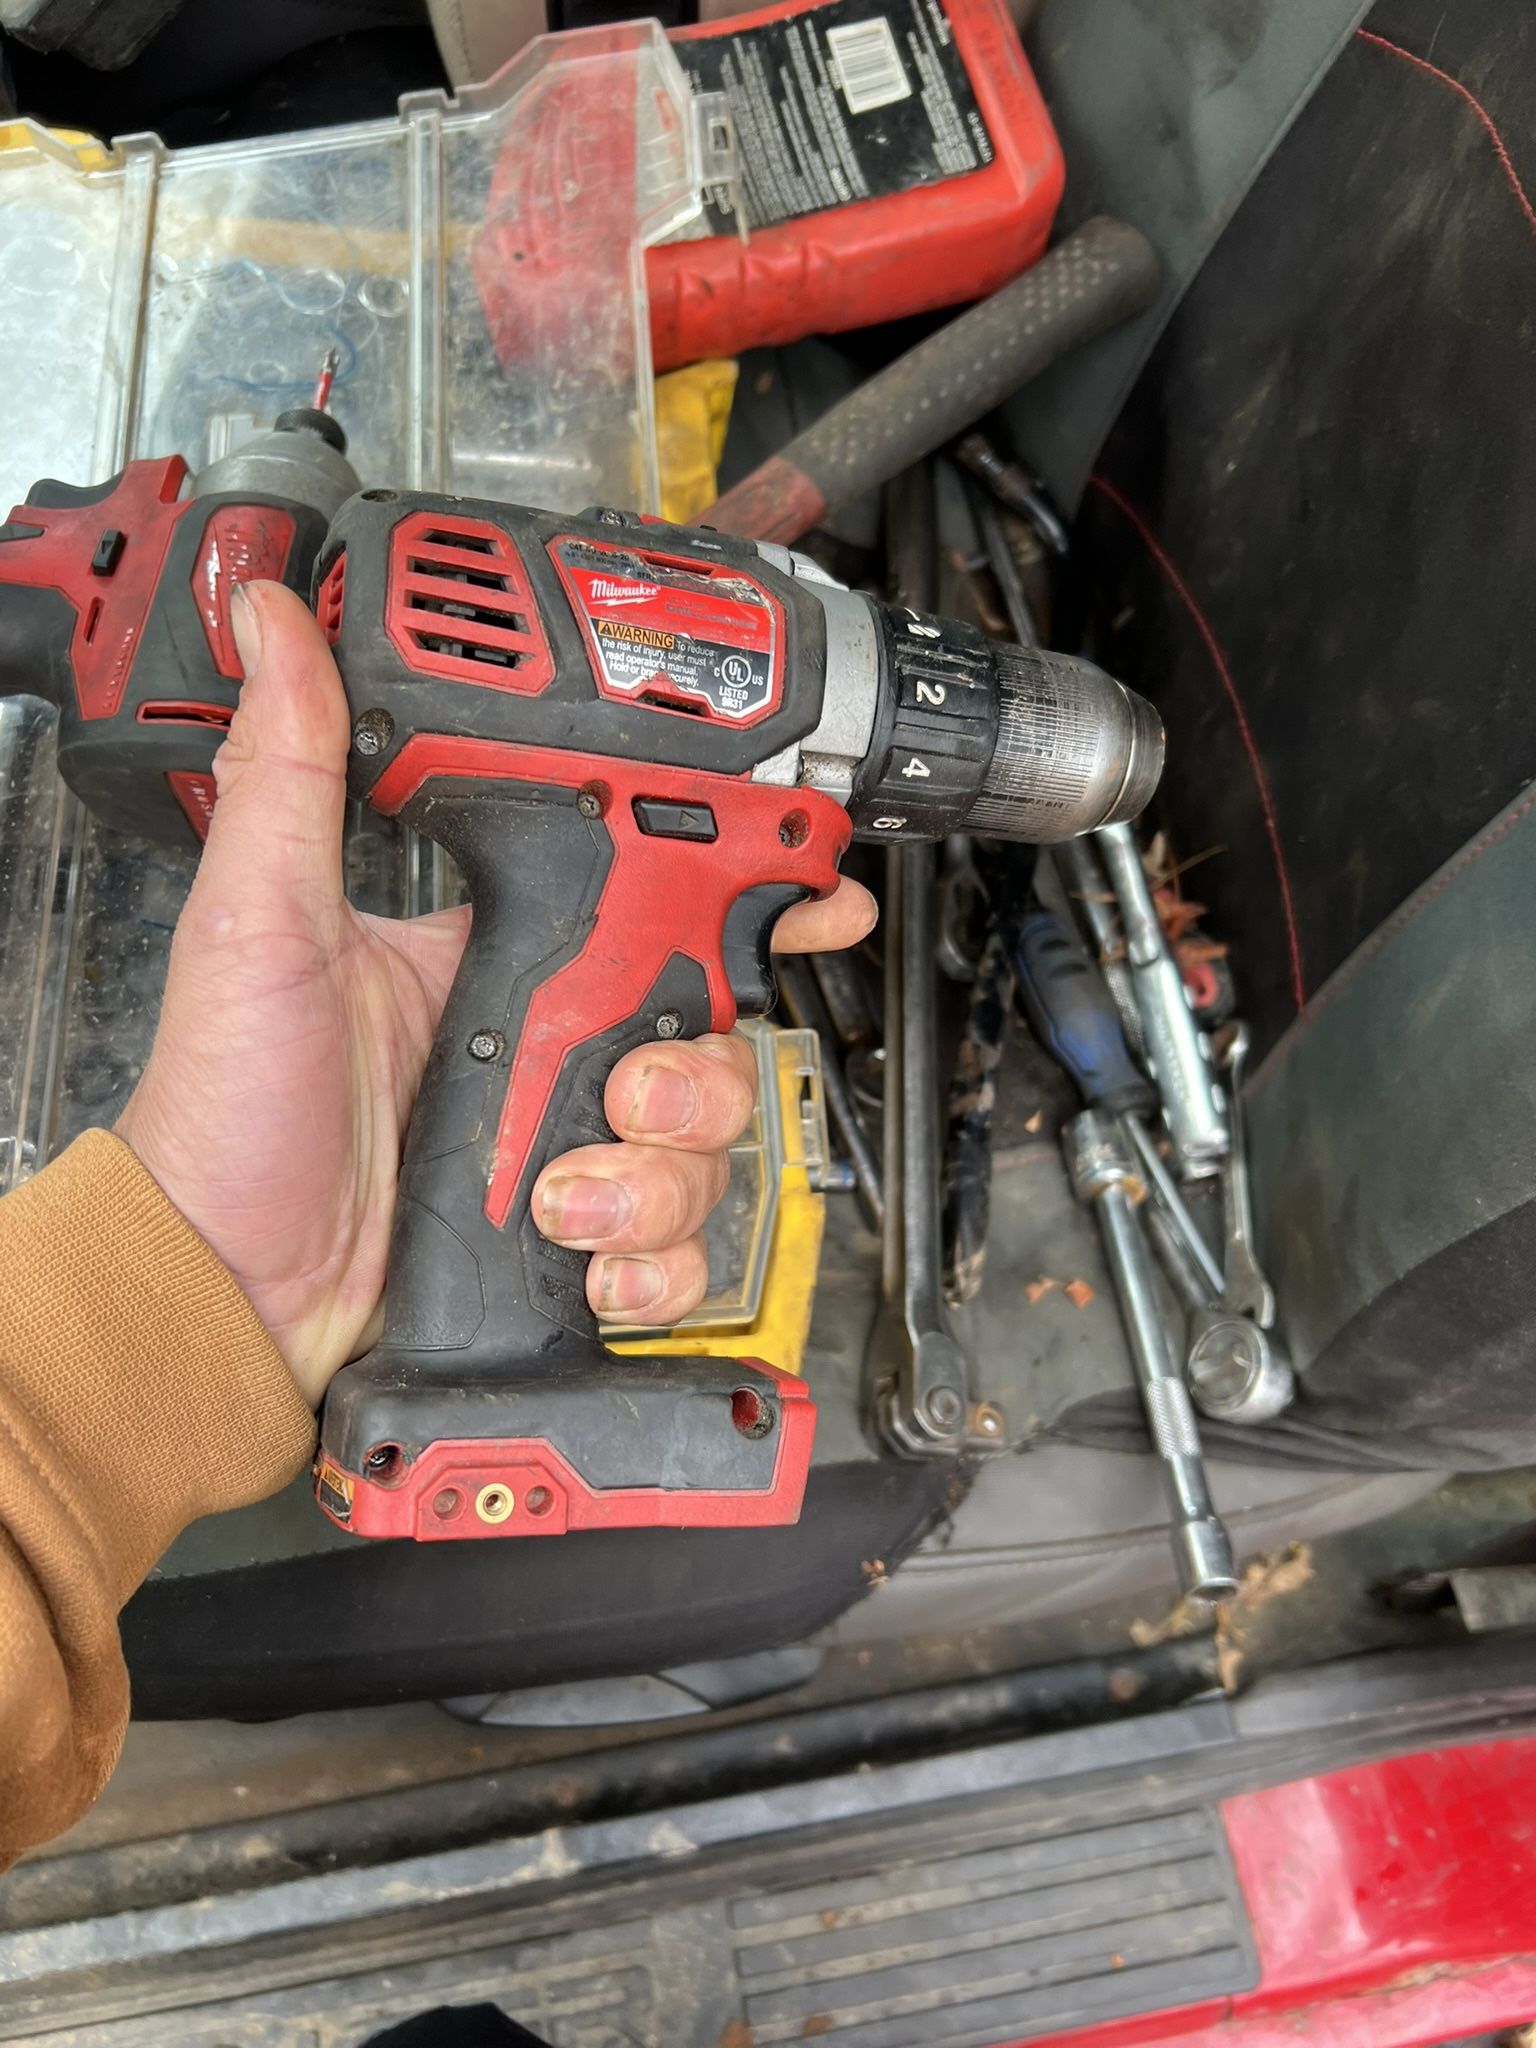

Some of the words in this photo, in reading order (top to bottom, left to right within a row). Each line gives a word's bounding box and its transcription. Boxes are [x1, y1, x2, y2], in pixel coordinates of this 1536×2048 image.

[588, 579, 658, 598] Milwaukee
[613, 624, 673, 648] WARNING
[677, 641, 687, 651] To
[602, 637, 616, 649] the
[617, 641, 633, 652] risk
[633, 643, 642, 653] of
[668, 651, 686, 662] user
[687, 655, 706, 667] must
[606, 650, 625, 662] read
[626, 654, 667, 669] operator's
[609, 660, 630, 673] Hold
[630, 664, 640, 673] or
[728, 661, 744, 682] UL
[751, 675, 764, 686] US
[719, 685, 749, 700] LISTED
[916, 680, 946, 706] 2
[901, 757, 931, 778] 4
[872, 817, 908, 830] 6
